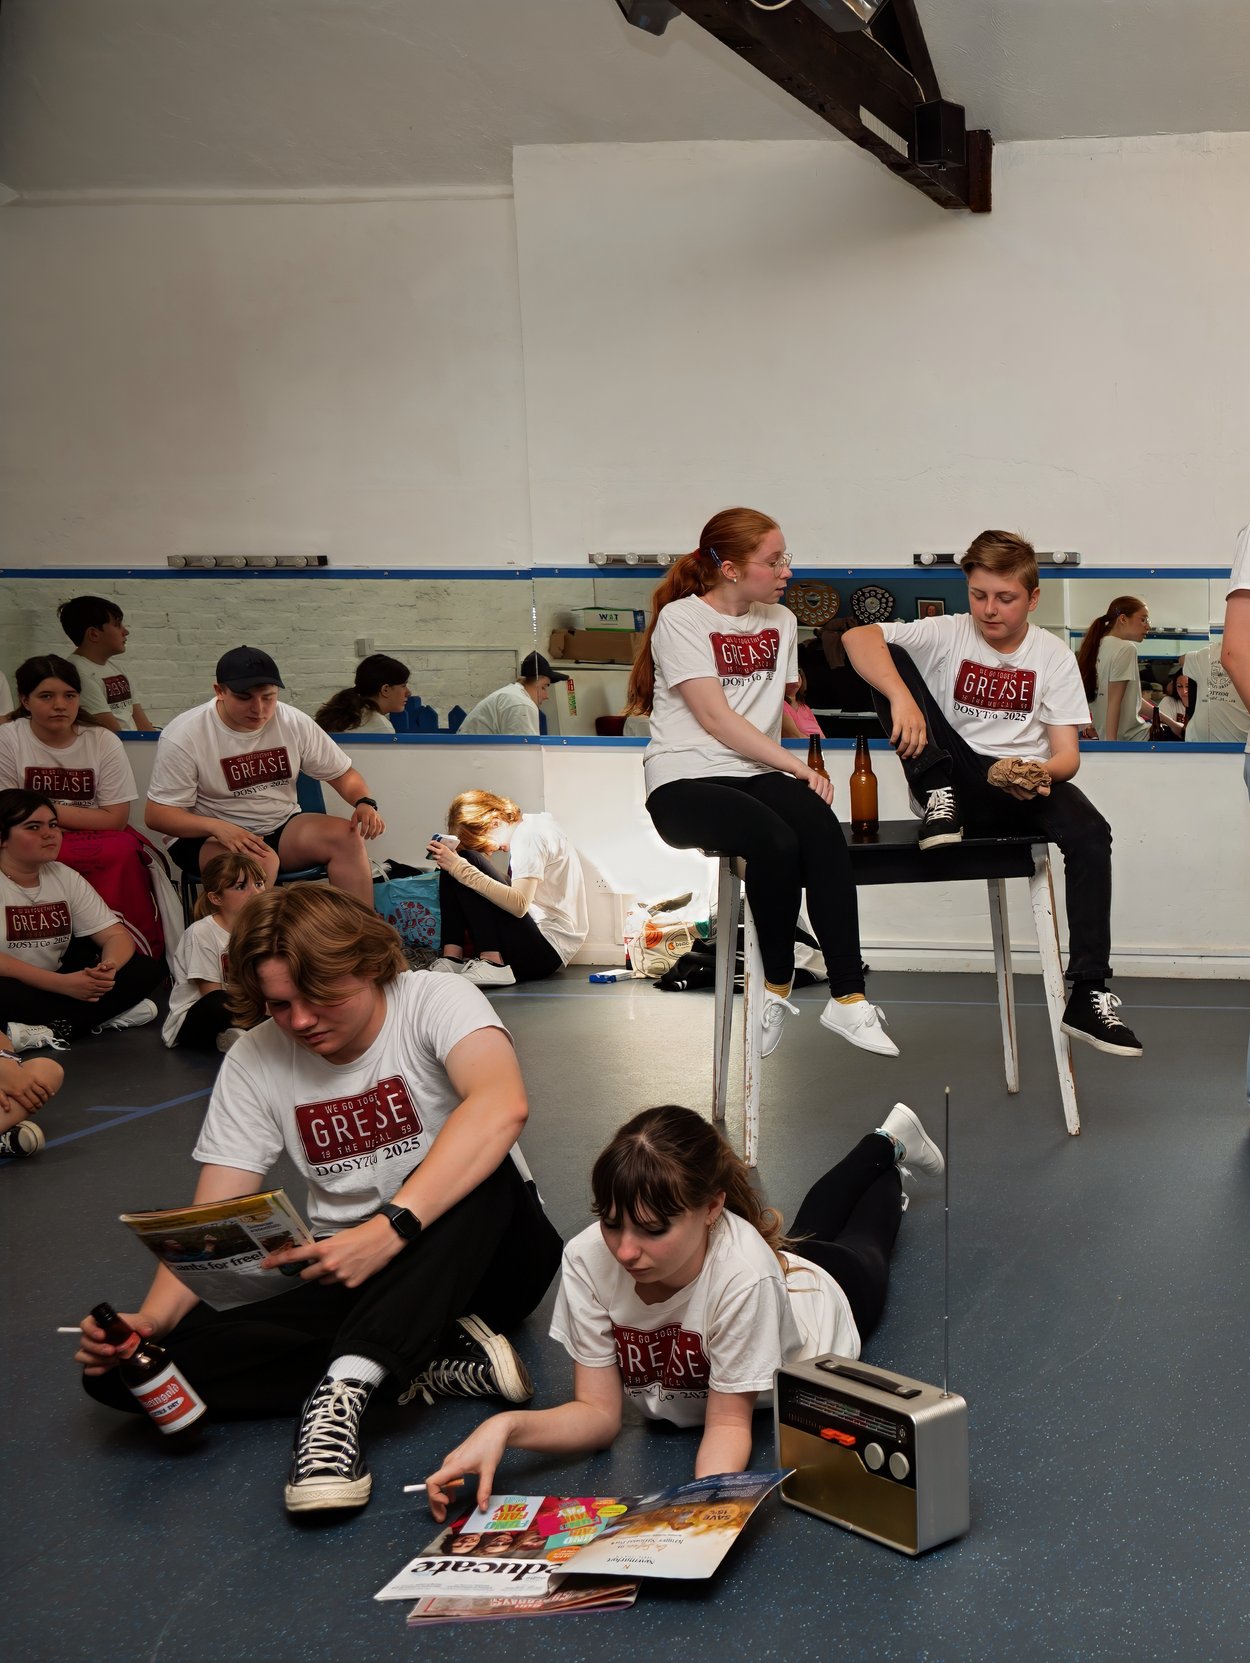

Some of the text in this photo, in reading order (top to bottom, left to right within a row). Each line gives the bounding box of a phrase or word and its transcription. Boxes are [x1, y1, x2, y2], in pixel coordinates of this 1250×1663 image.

[721, 638, 778, 666] GREASE
[963, 673, 1030, 701] GREASE
[1003, 712, 1028, 721] 2025
[230, 755, 287, 781] GREASE
[32, 775, 91, 793] GREASE
[12, 910, 69, 932] GREASE
[324, 1103, 339, 1115] WE
[341, 1100, 354, 1111] GO
[310, 1092, 408, 1148] GRESE
[401, 1124, 412, 1134] 59
[337, 1143, 359, 1156] THE
[382, 1137, 421, 1161] 2025
[208, 1261, 229, 1270] for
[230, 1250, 266, 1267] free!
[622, 1331, 636, 1342] WE
[638, 1335, 650, 1344] GO
[492, 1511, 529, 1521] FAIR
[494, 1503, 528, 1513] PAY
[411, 1559, 563, 1582] educate
